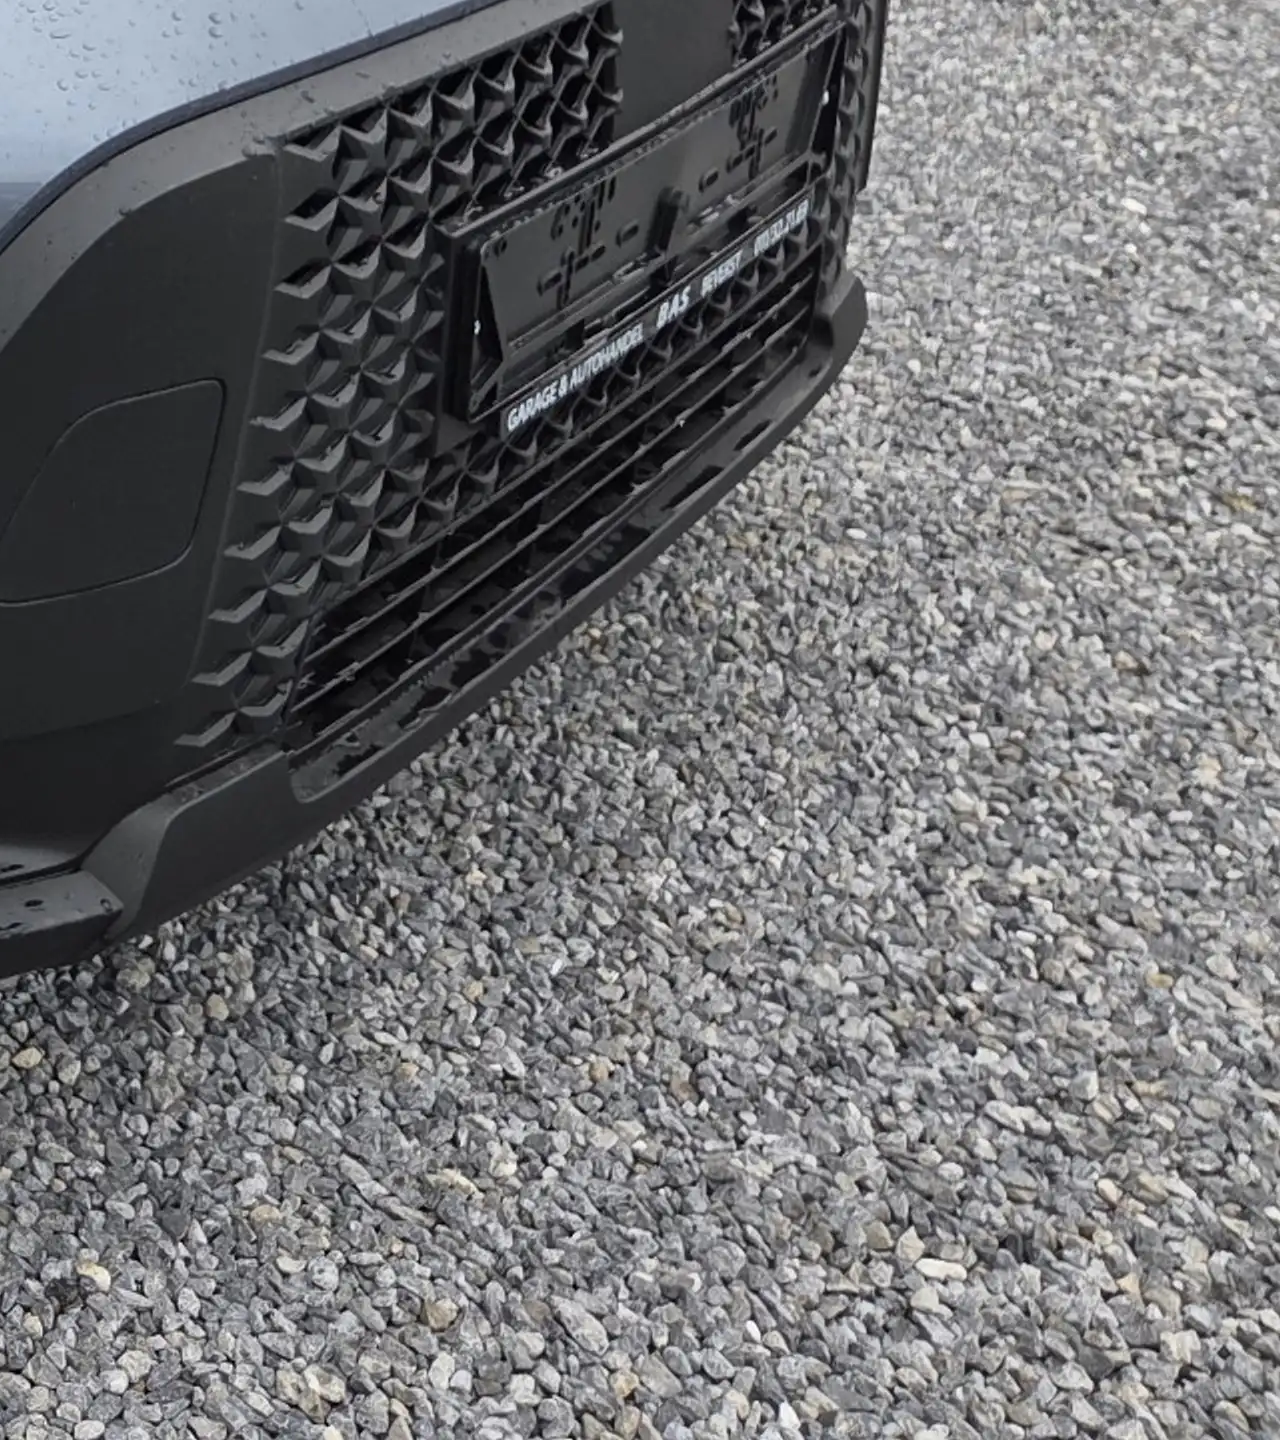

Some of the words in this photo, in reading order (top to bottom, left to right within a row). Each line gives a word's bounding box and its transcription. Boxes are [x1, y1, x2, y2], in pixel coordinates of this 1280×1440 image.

[507, 381, 558, 432] GARAGE
[569, 322, 644, 390] AUTOHANDEL
[656, 285, 691, 329] BAS
